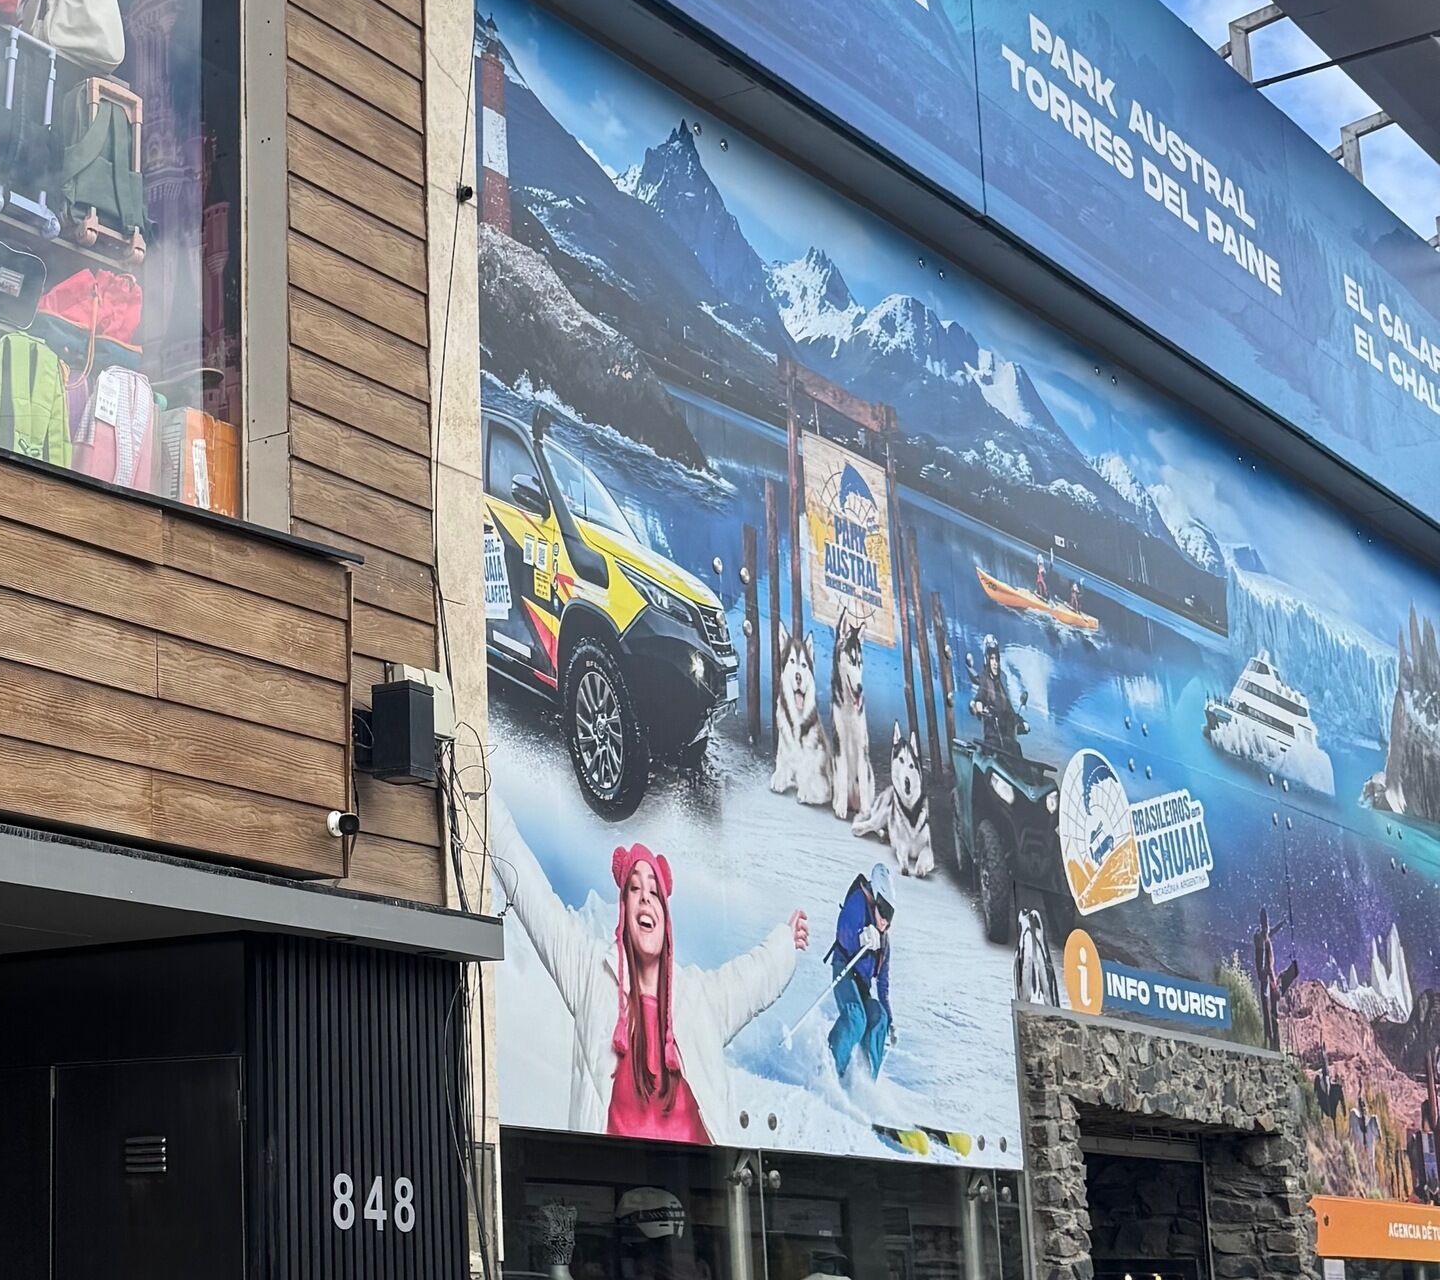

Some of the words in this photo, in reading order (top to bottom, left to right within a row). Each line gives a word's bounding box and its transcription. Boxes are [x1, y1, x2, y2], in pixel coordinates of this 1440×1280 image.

[1029, 13, 1118, 119] PARK
[1128, 99, 1256, 230] AUSTRAL
[1001, 44, 1135, 180] TORRES
[1141, 156, 1200, 232] DEL
[1205, 206, 1283, 296] PAINE
[1344, 273, 1374, 323] EL
[1353, 323, 1384, 373] EL
[833, 515, 868, 558] PARK
[824, 542, 882, 594] AUSTRAL
[1131, 795, 1191, 836] BRASILEIROS
[1137, 821, 1211, 888] USHUAIA
[1106, 972, 1150, 1006] INFO
[1154, 984, 1227, 1020] TOURIST
[332, 1172, 416, 1232] 848
[1388, 1222, 1421, 1240] AGENCIA
